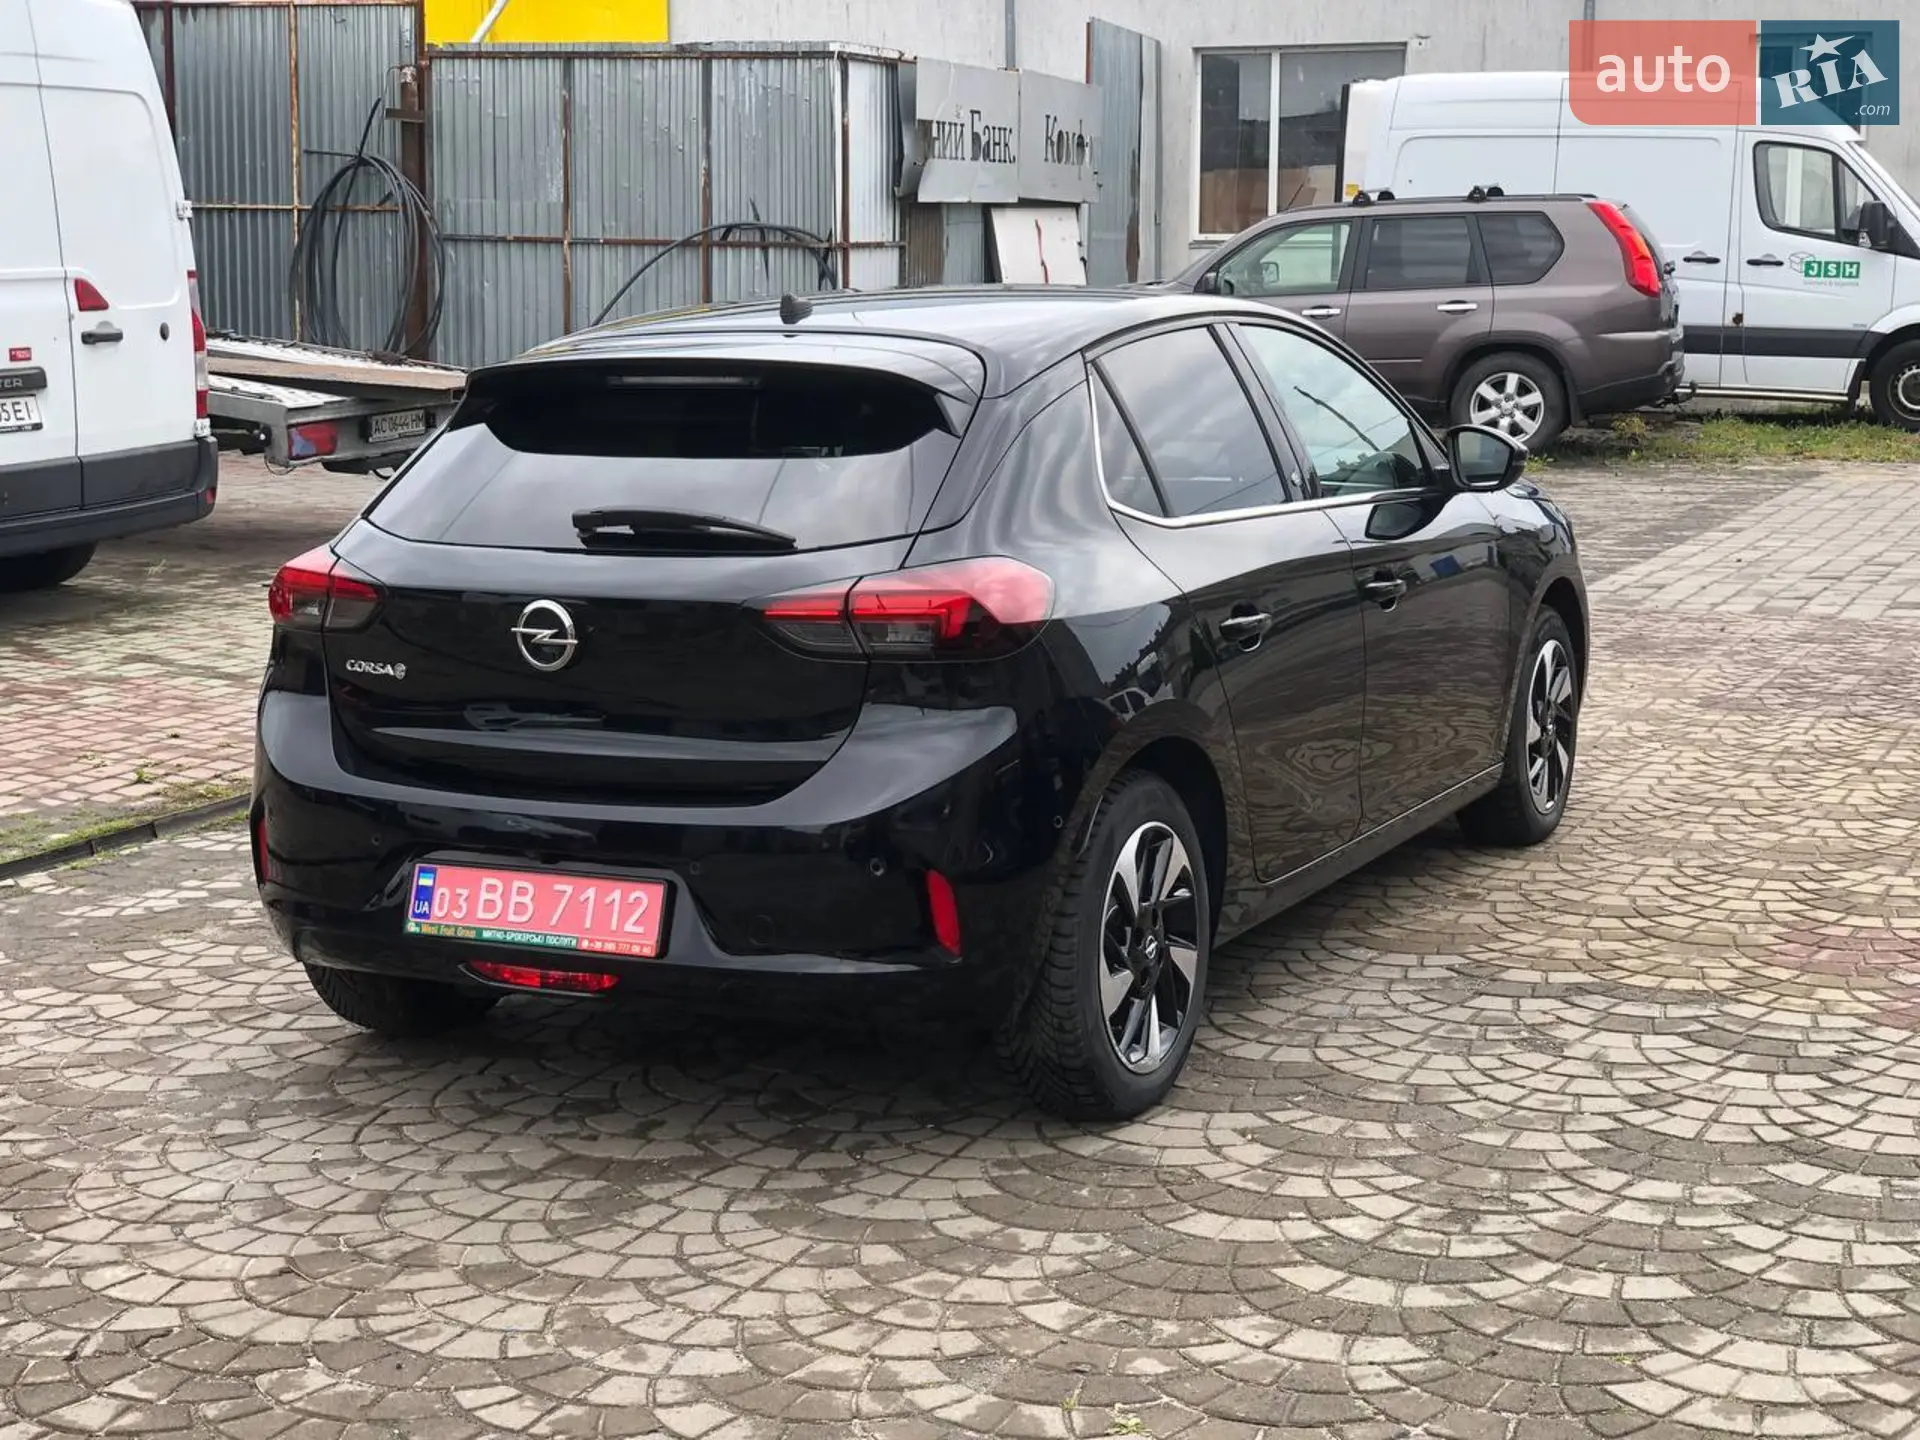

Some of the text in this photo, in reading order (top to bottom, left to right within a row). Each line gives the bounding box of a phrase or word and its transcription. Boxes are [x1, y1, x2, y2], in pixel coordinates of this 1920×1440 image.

[1807, 262, 1859, 277] JSH
[346, 659, 394, 676] CORSA
[414, 901, 430, 914] UA
[433, 877, 650, 934] 03 BB 7112
